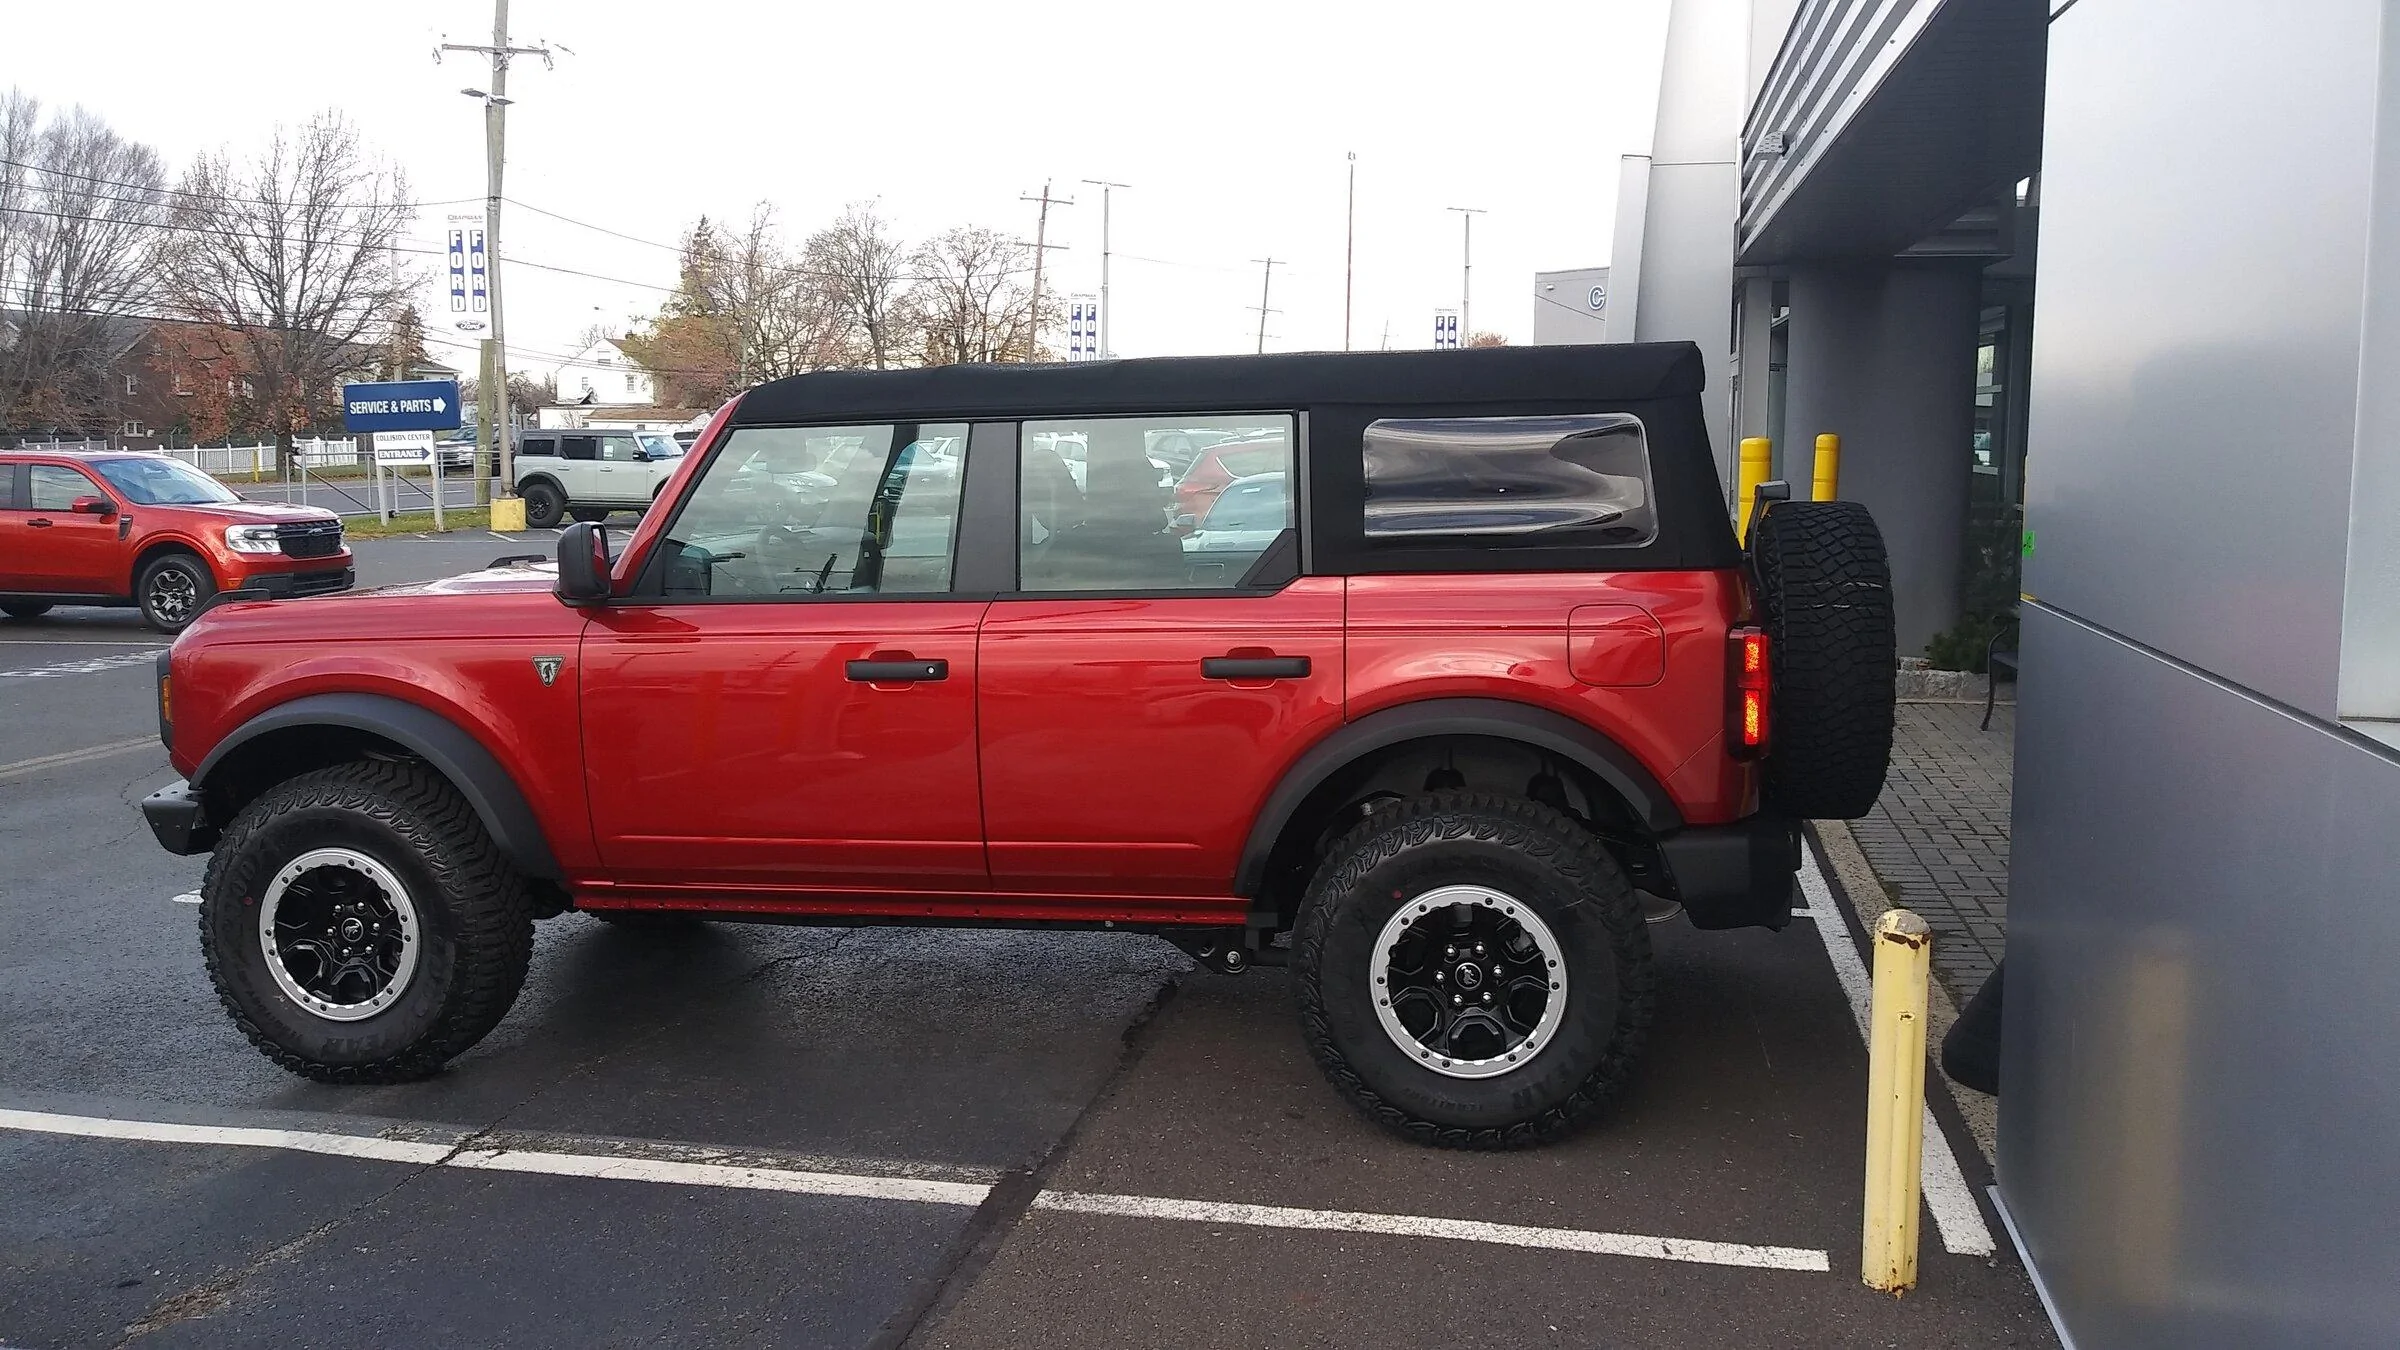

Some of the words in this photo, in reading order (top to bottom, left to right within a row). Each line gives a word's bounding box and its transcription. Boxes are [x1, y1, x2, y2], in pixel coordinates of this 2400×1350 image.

[450, 230, 465, 311] FORD
[470, 230, 486, 311] FORD
[1589, 286, 1604, 309] C
[459, 321, 481, 330] Ford
[349, 401, 389, 414] SERVICE
[390, 401, 399, 413] &
[400, 399, 431, 412] PARTS
[376, 433, 405, 441] COLLISION
[407, 433, 431, 441] CENTER
[379, 449, 423, 458] ENTRANCE
